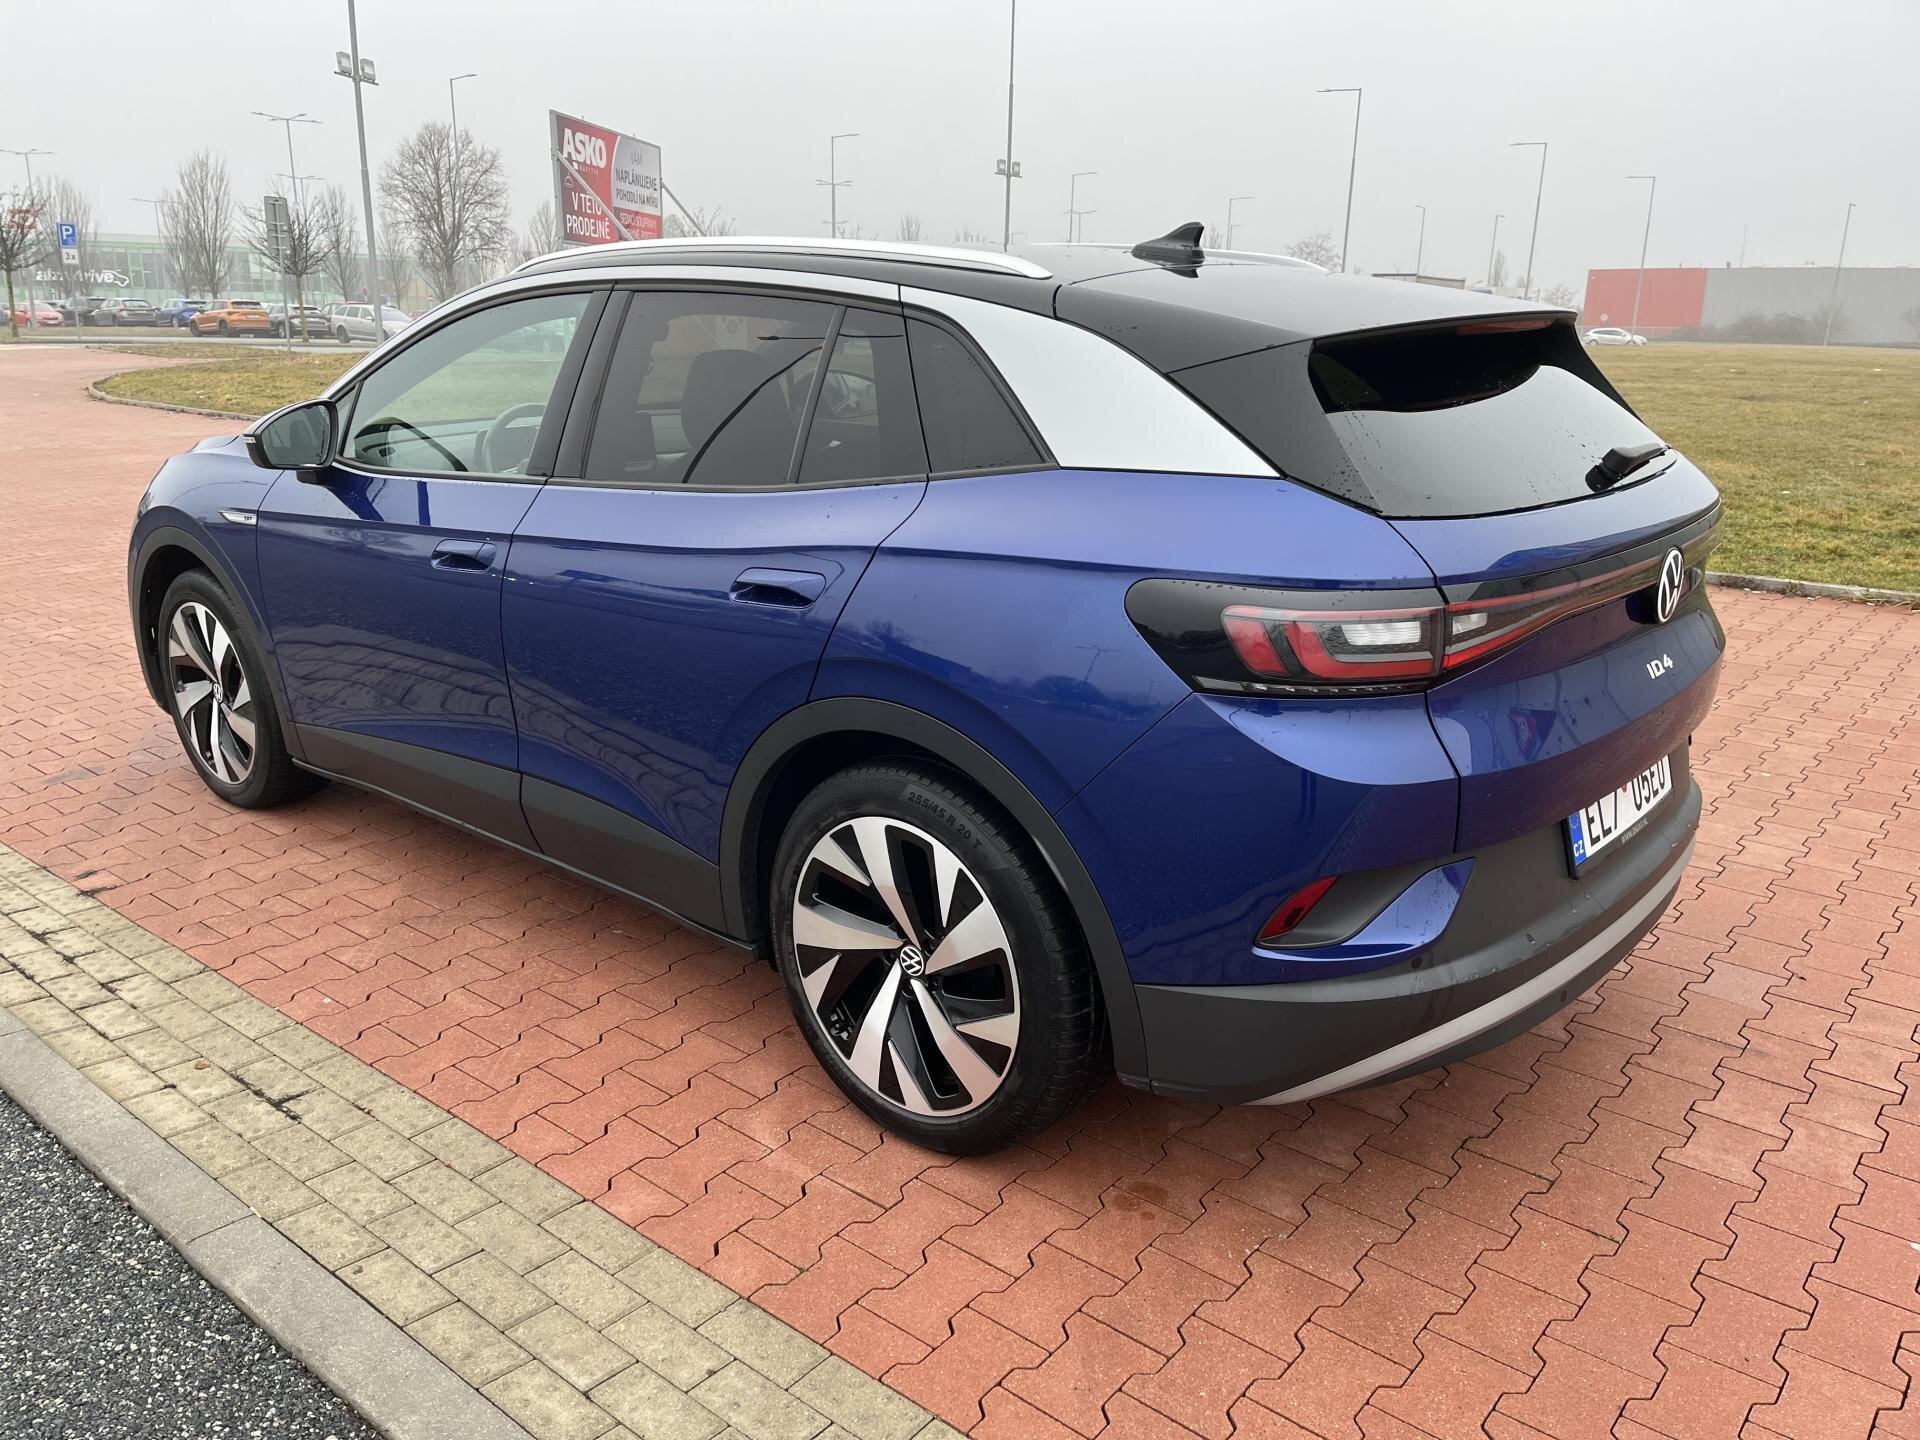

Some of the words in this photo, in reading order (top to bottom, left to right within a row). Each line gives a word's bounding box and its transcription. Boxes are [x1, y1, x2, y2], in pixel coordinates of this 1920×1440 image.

[562, 128, 607, 169] ASKO
[571, 191, 579, 211] V
[62, 226, 73, 240] P
[566, 214, 611, 240] PRODEJNĚ
[907, 792, 946, 818] 255/45
[946, 814, 957, 828] R
[956, 824, 972, 840] 20
[1573, 839, 1585, 857] CZ
